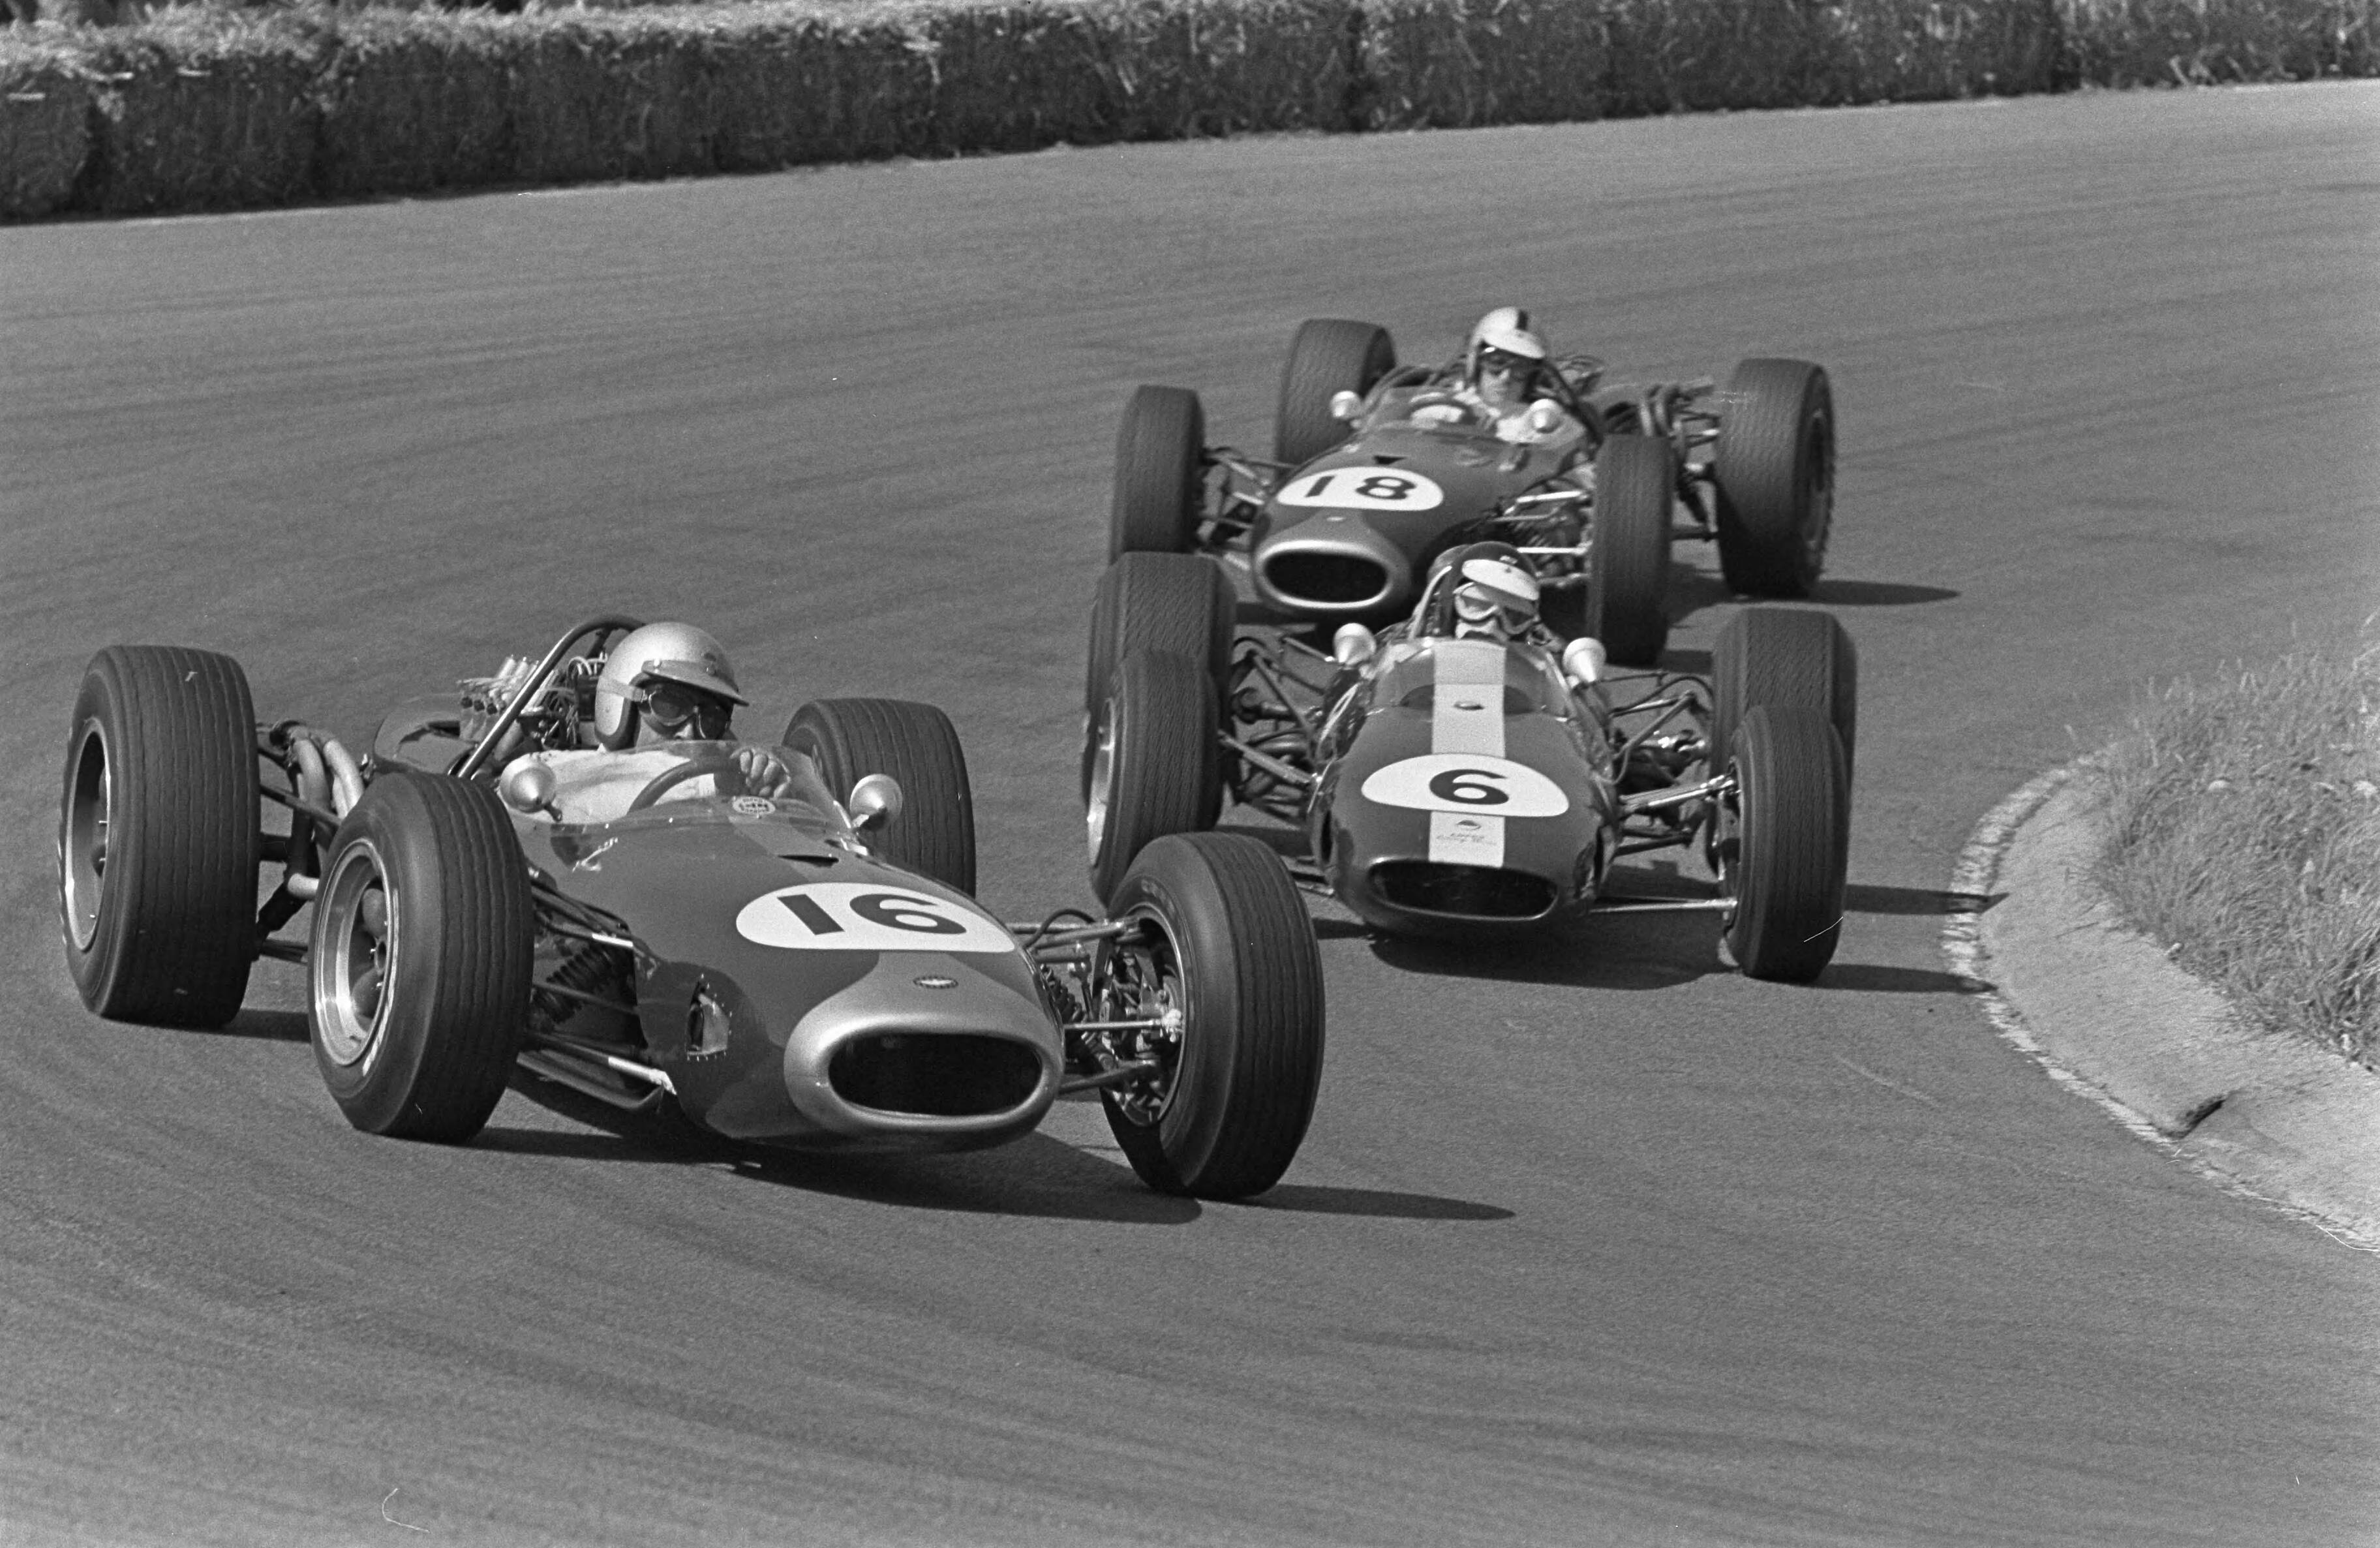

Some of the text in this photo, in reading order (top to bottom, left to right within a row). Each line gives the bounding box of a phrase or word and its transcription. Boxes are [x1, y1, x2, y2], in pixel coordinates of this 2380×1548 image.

[1305, 476, 1416, 500] 18
[1429, 769, 1509, 805] 6
[777, 894, 967, 935] 16
